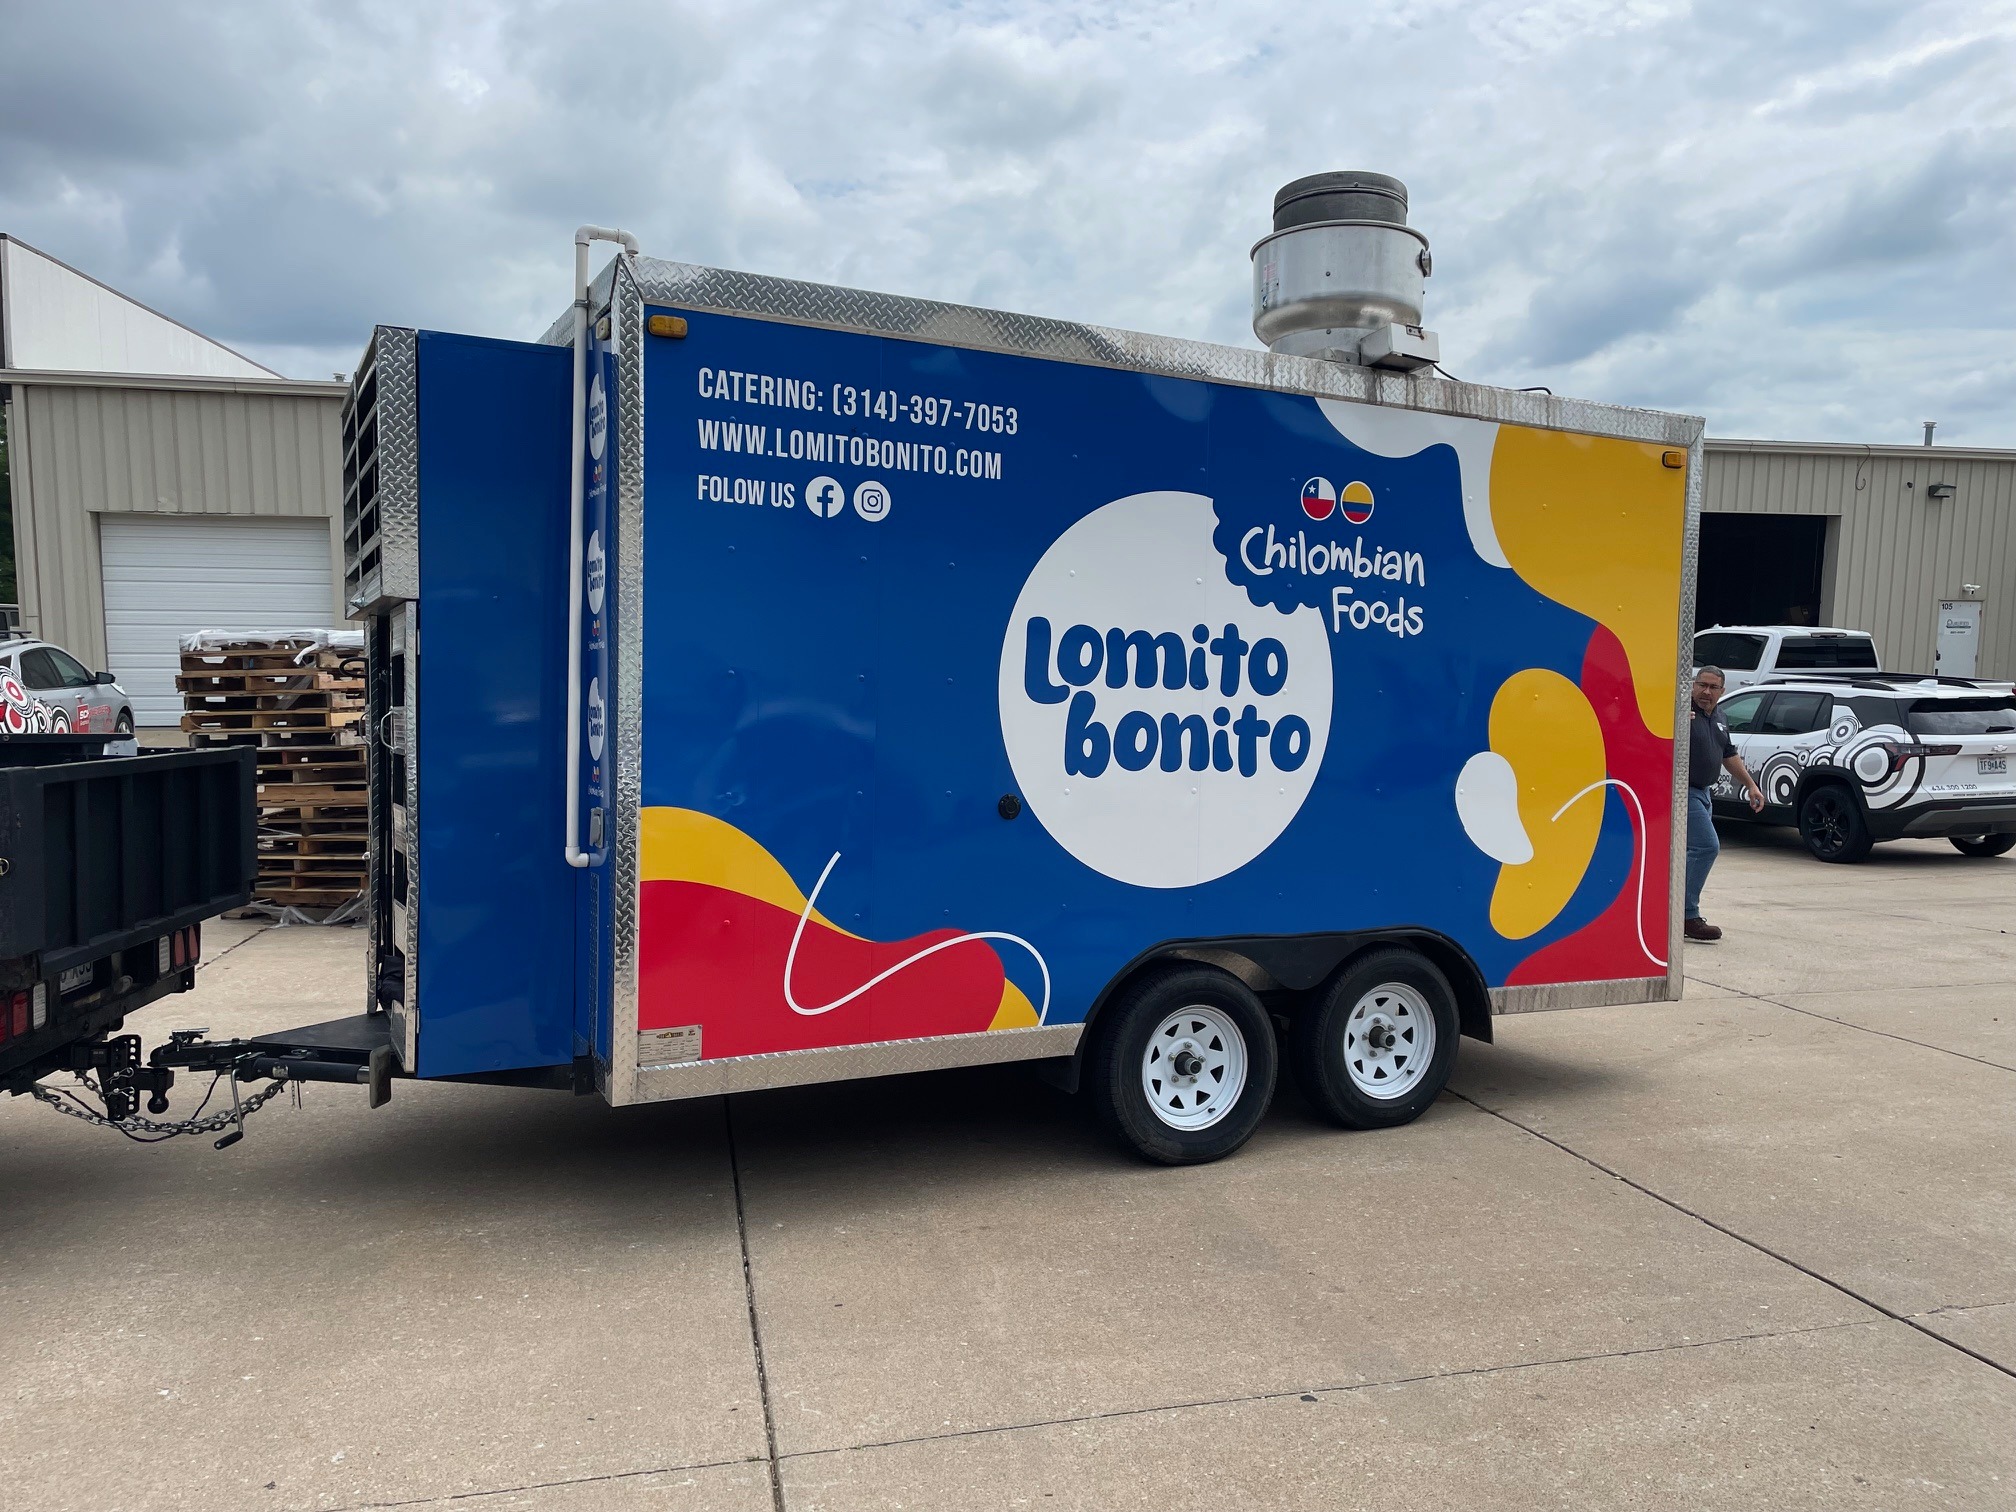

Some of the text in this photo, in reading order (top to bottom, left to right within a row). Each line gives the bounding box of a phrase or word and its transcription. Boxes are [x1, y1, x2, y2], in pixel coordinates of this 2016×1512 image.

[698, 366, 1019, 435] CATERING: (314)-397-7053
[697, 418, 1002, 480] WWW.LOMITOBONITO.COM
[697, 474, 766, 507] FOLOW
[770, 482, 796, 509] US
[1240, 523, 1425, 587] Chilombian
[1332, 586, 1424, 638] Foods
[1024, 616, 1289, 705] Lomito
[1063, 690, 1311, 779] bonito
